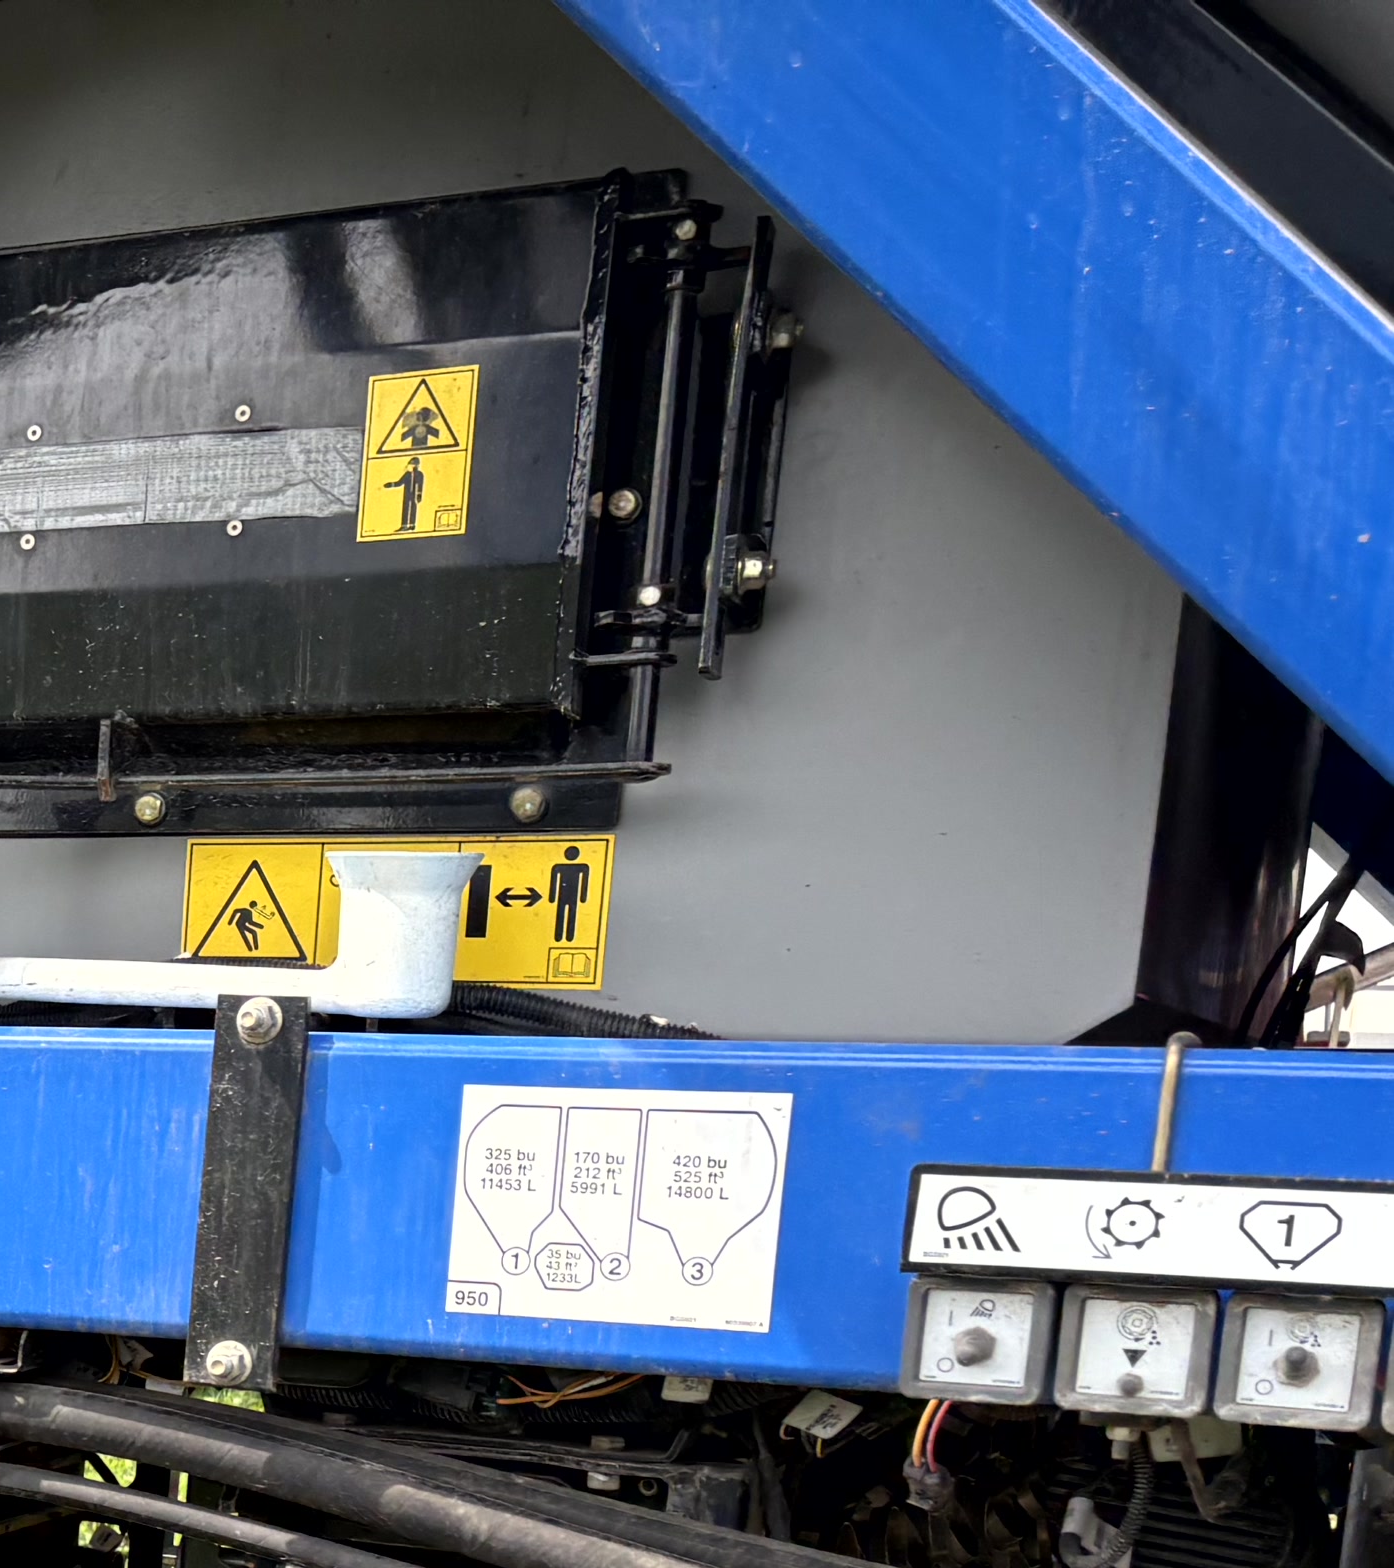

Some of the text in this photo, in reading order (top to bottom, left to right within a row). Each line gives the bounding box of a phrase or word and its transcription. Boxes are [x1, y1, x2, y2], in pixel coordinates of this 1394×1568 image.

[484, 1147, 536, 1162] 325 bu
[574, 1151, 625, 1165] 170 bu
[485, 1162, 513, 1176] 406
[672, 1155, 728, 1169] 420 bu
[574, 1166, 601, 1179] 212
[673, 1170, 702, 1183] 525
[480, 1177, 537, 1192] 11453 L
[569, 1181, 623, 1195] 5991 L
[666, 1185, 729, 1200] 14800 L
[1277, 1214, 1295, 1247] 1
[511, 1252, 520, 1270] 1
[546, 1249, 582, 1260] 35 bu
[545, 1260, 561, 1271] 43
[608, 1257, 623, 1276] 2
[690, 1262, 704, 1281] 3
[454, 1289, 489, 1307] 950
